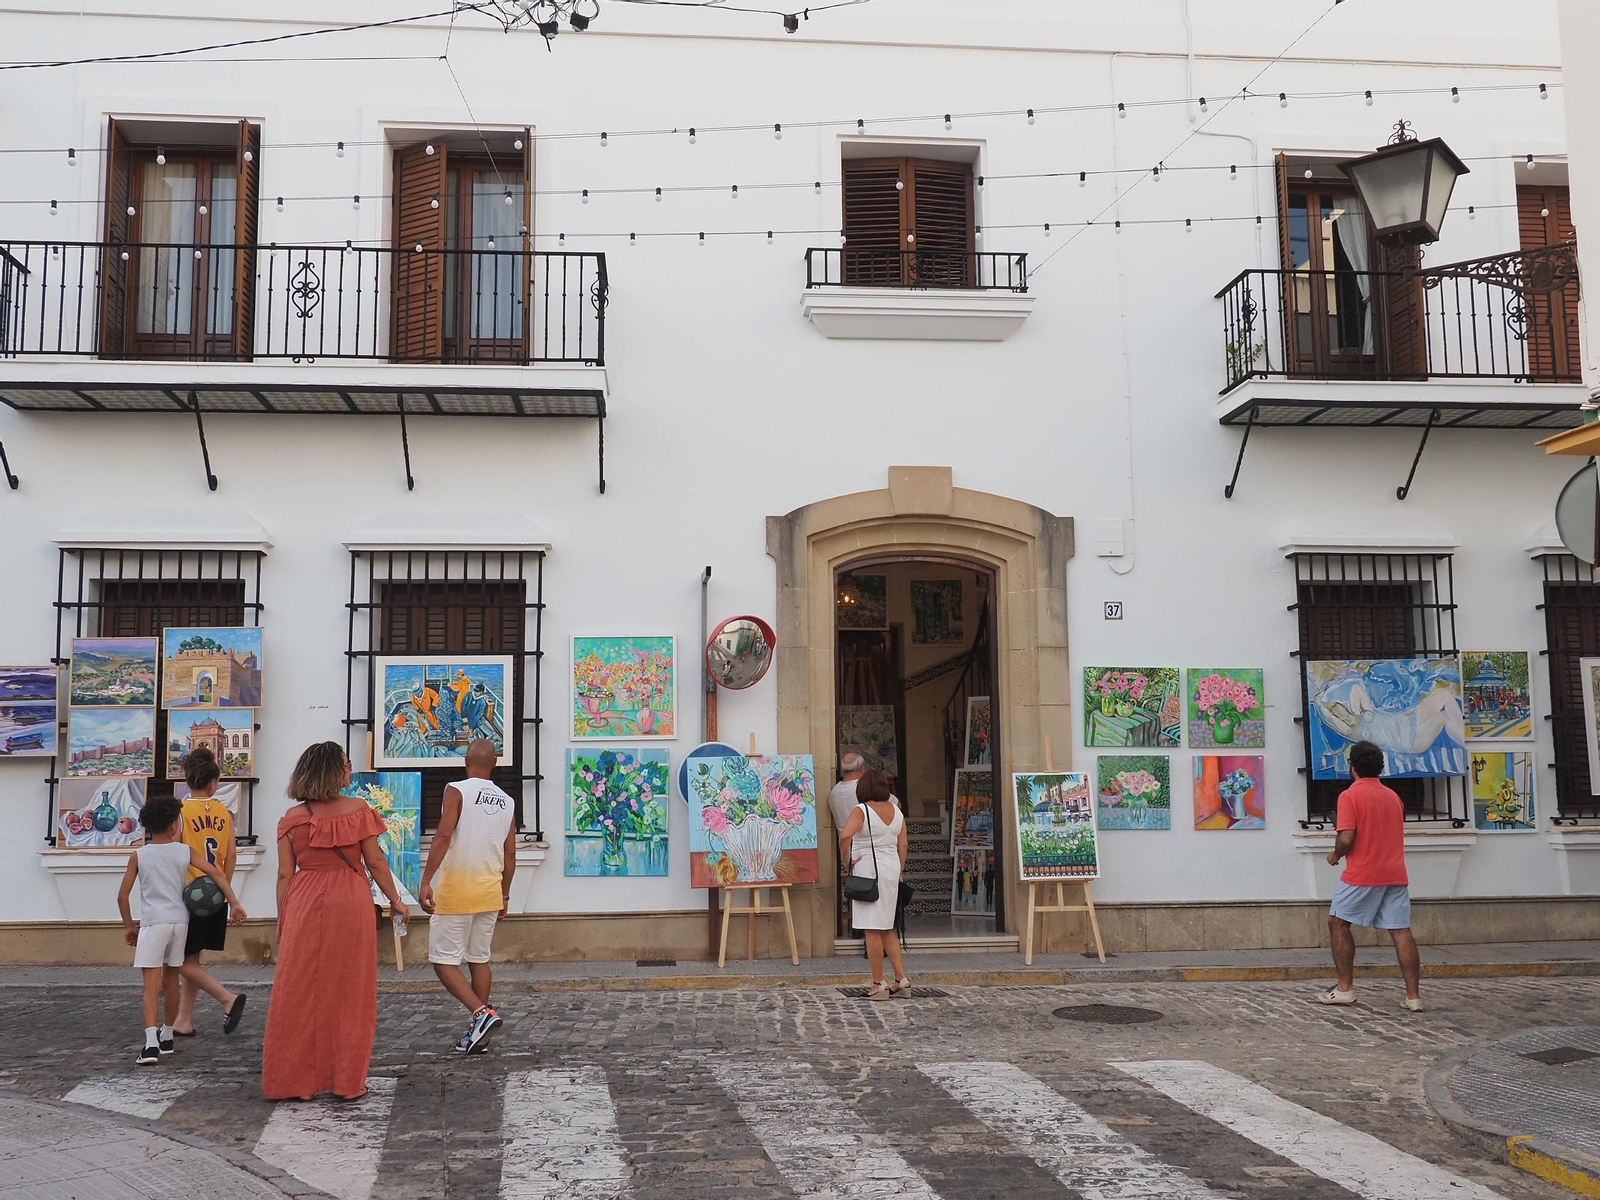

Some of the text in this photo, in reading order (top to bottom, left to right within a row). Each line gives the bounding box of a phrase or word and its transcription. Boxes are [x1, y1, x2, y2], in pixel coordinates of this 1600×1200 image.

[1107, 604, 1120, 617] 37
[473, 791, 507, 810] LAKERS
[192, 814, 226, 833] JAMES
[205, 836, 220, 868] 6
